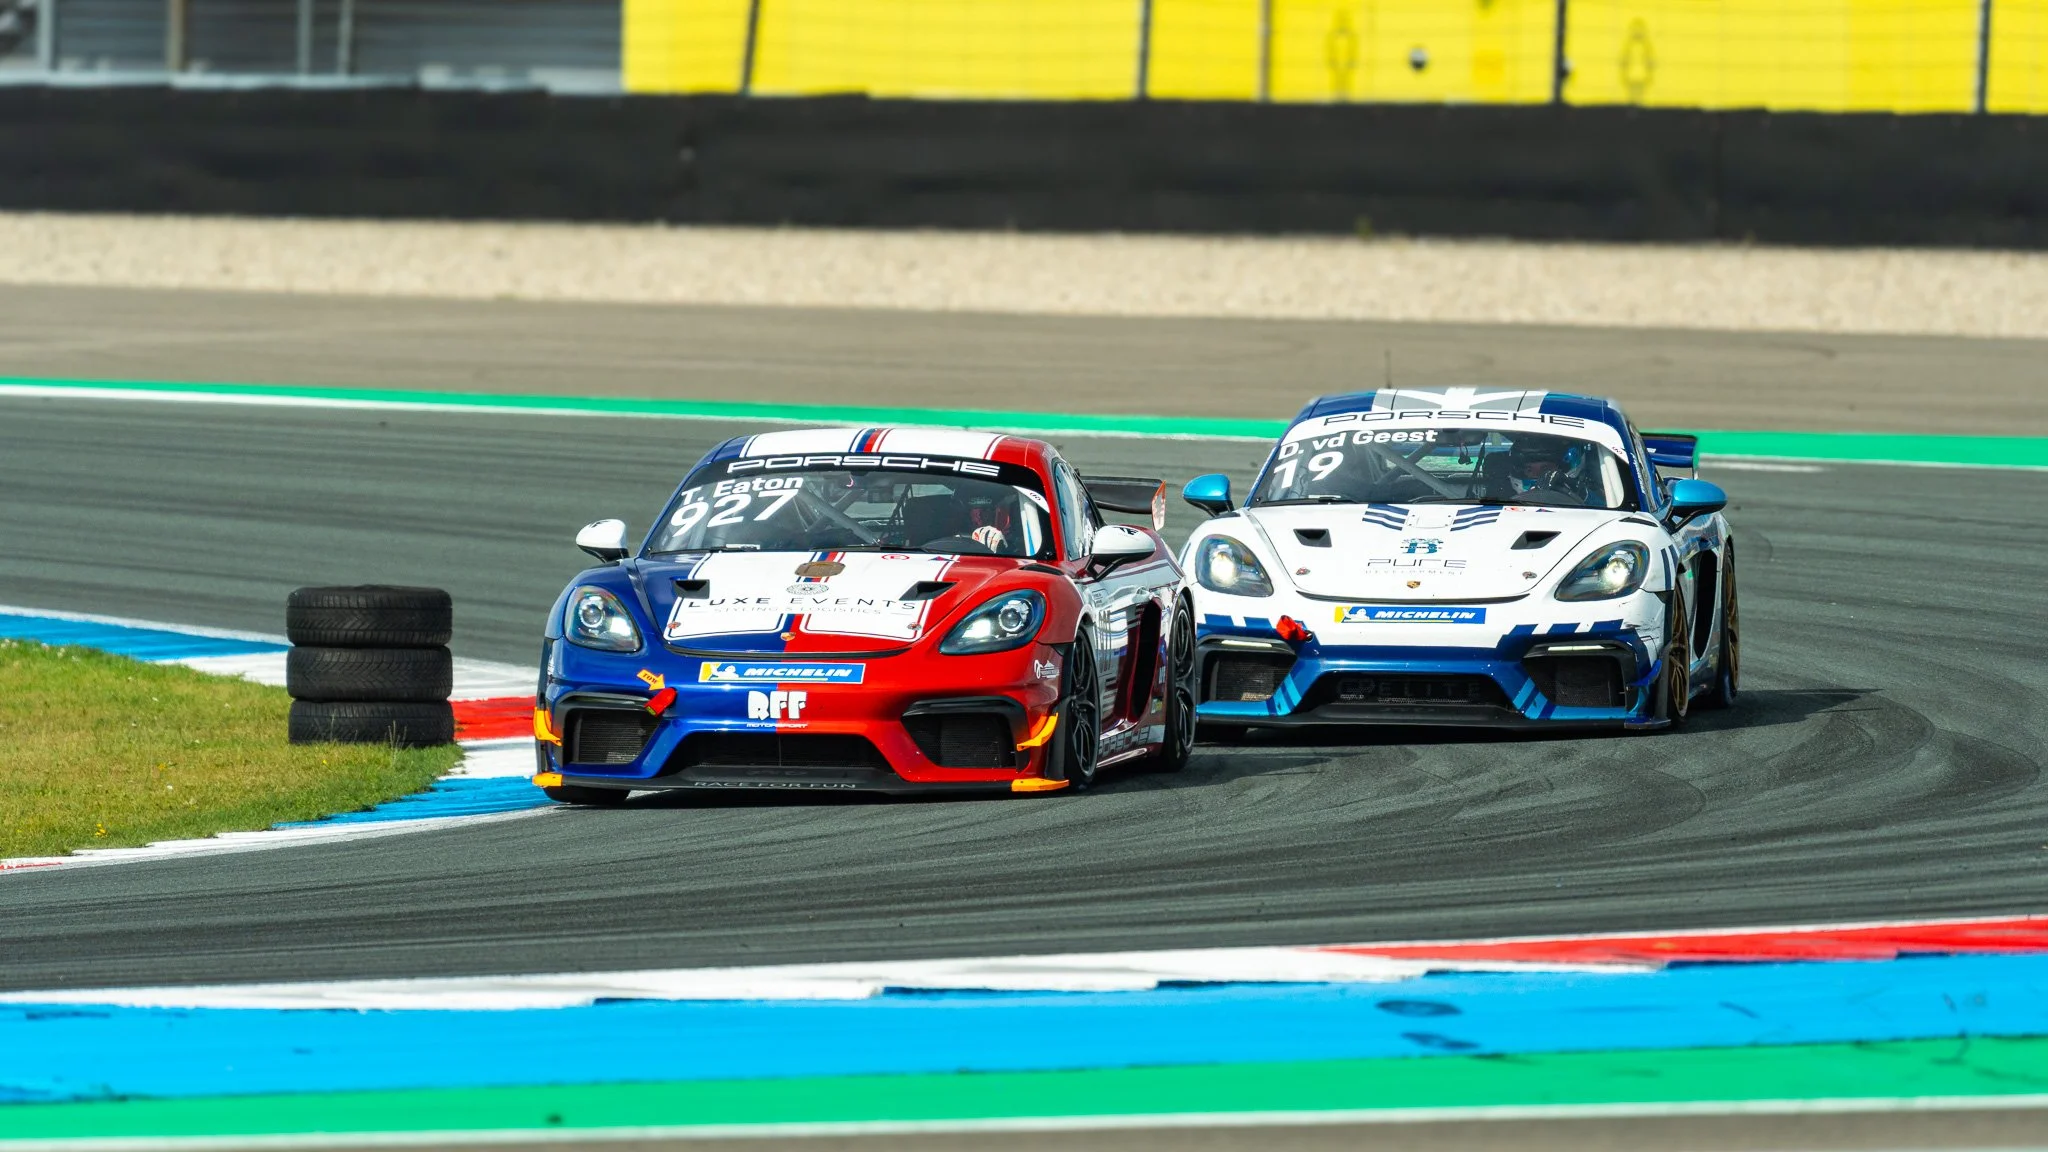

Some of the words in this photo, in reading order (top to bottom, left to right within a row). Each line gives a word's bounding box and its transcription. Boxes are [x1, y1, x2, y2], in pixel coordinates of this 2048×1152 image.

[1324, 410, 1585, 428] PORSCHE
[1278, 442, 1305, 460] D.
[1312, 432, 1347, 451] vd
[1352, 429, 1439, 445] Geest
[726, 455, 1001, 477] PORSCHE
[1273, 451, 1344, 489] 19
[681, 486, 705, 506] T.
[713, 476, 804, 499] Eaton
[670, 488, 799, 538] 927
[1367, 558, 1468, 569] PURE
[688, 597, 771, 608] LUXE
[789, 597, 916, 610] EVENTS
[800, 606, 881, 614] LOGISTICS
[1374, 611, 1476, 619] MICHELIN
[642, 672, 657, 685] TOW
[743, 668, 853, 677] MICHELIN
[747, 690, 807, 720] RFF
